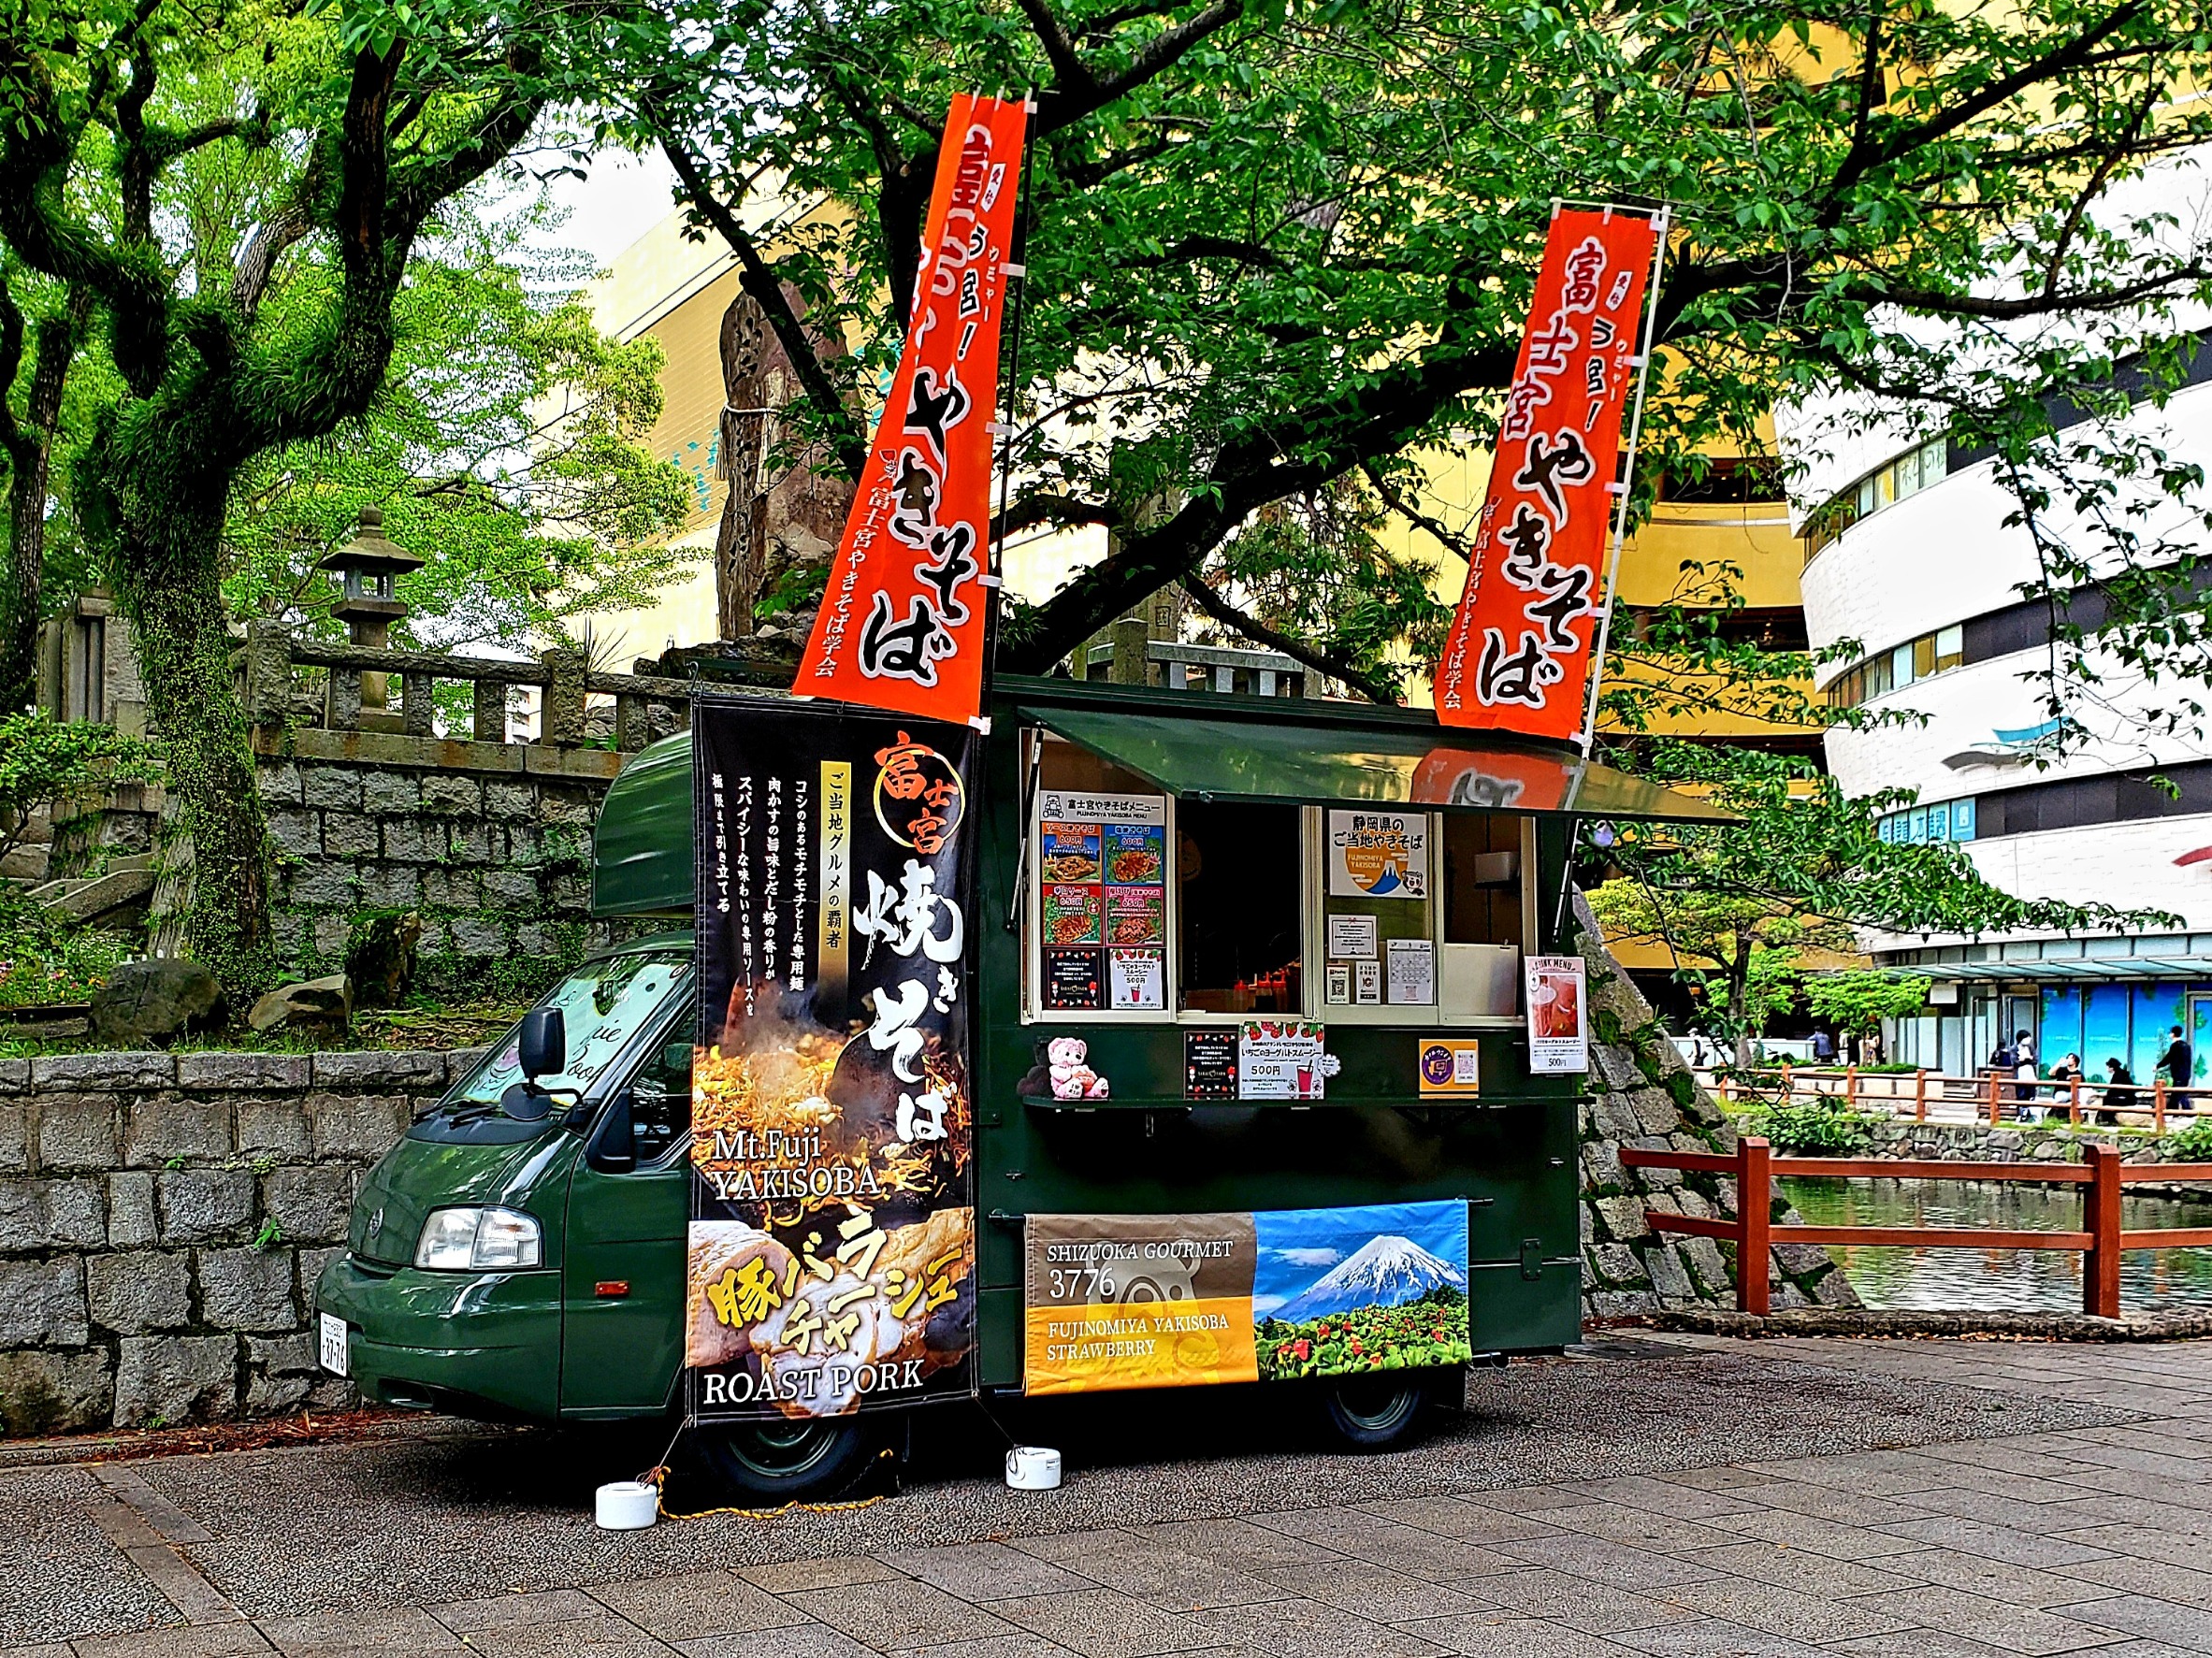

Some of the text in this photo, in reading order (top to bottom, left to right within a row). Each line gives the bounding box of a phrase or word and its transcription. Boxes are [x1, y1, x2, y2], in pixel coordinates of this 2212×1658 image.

[1502, 236, 1608, 440] 富士宮
[859, 366, 978, 688] やきそば
[815, 485, 894, 679] 富士宮やきそば学会
[1475, 426, 1596, 709] やきそば
[875, 730, 960, 855] 富士宮
[1067, 799, 1161, 813] 富士宮やきそばメニュー
[712, 772, 731, 914] 極限まで引き立てる
[1334, 831, 1424, 851] ご当地やきそば
[1352, 815, 1405, 832] 静岡県の
[825, 771, 845, 950] ご当地グルメの覇者
[736, 776, 756, 1017] スパイシーな味わいの専用ソースを
[788, 780, 809, 991] コシのあるモチモチとした専用麺
[1553, 959, 1573, 972] MENU
[853, 858, 965, 1142] 焼きそば
[1241, 1048, 1323, 1057] いちごのヨーグルトスムージー
[1251, 1065, 1280, 1075] 500円
[713, 1126, 821, 1166] Mt.Fuji
[713, 1166, 880, 1202] YAKISOBA
[1047, 1241, 1234, 1262] SHIZUOKA GOURMET
[1048, 1267, 1117, 1299] 3776
[1048, 1314, 1229, 1338] FUJINOMIYA YAKISOBA
[1047, 1339, 1156, 1362] STRAWBERRY
[703, 1359, 925, 1405] ROAST PORK
